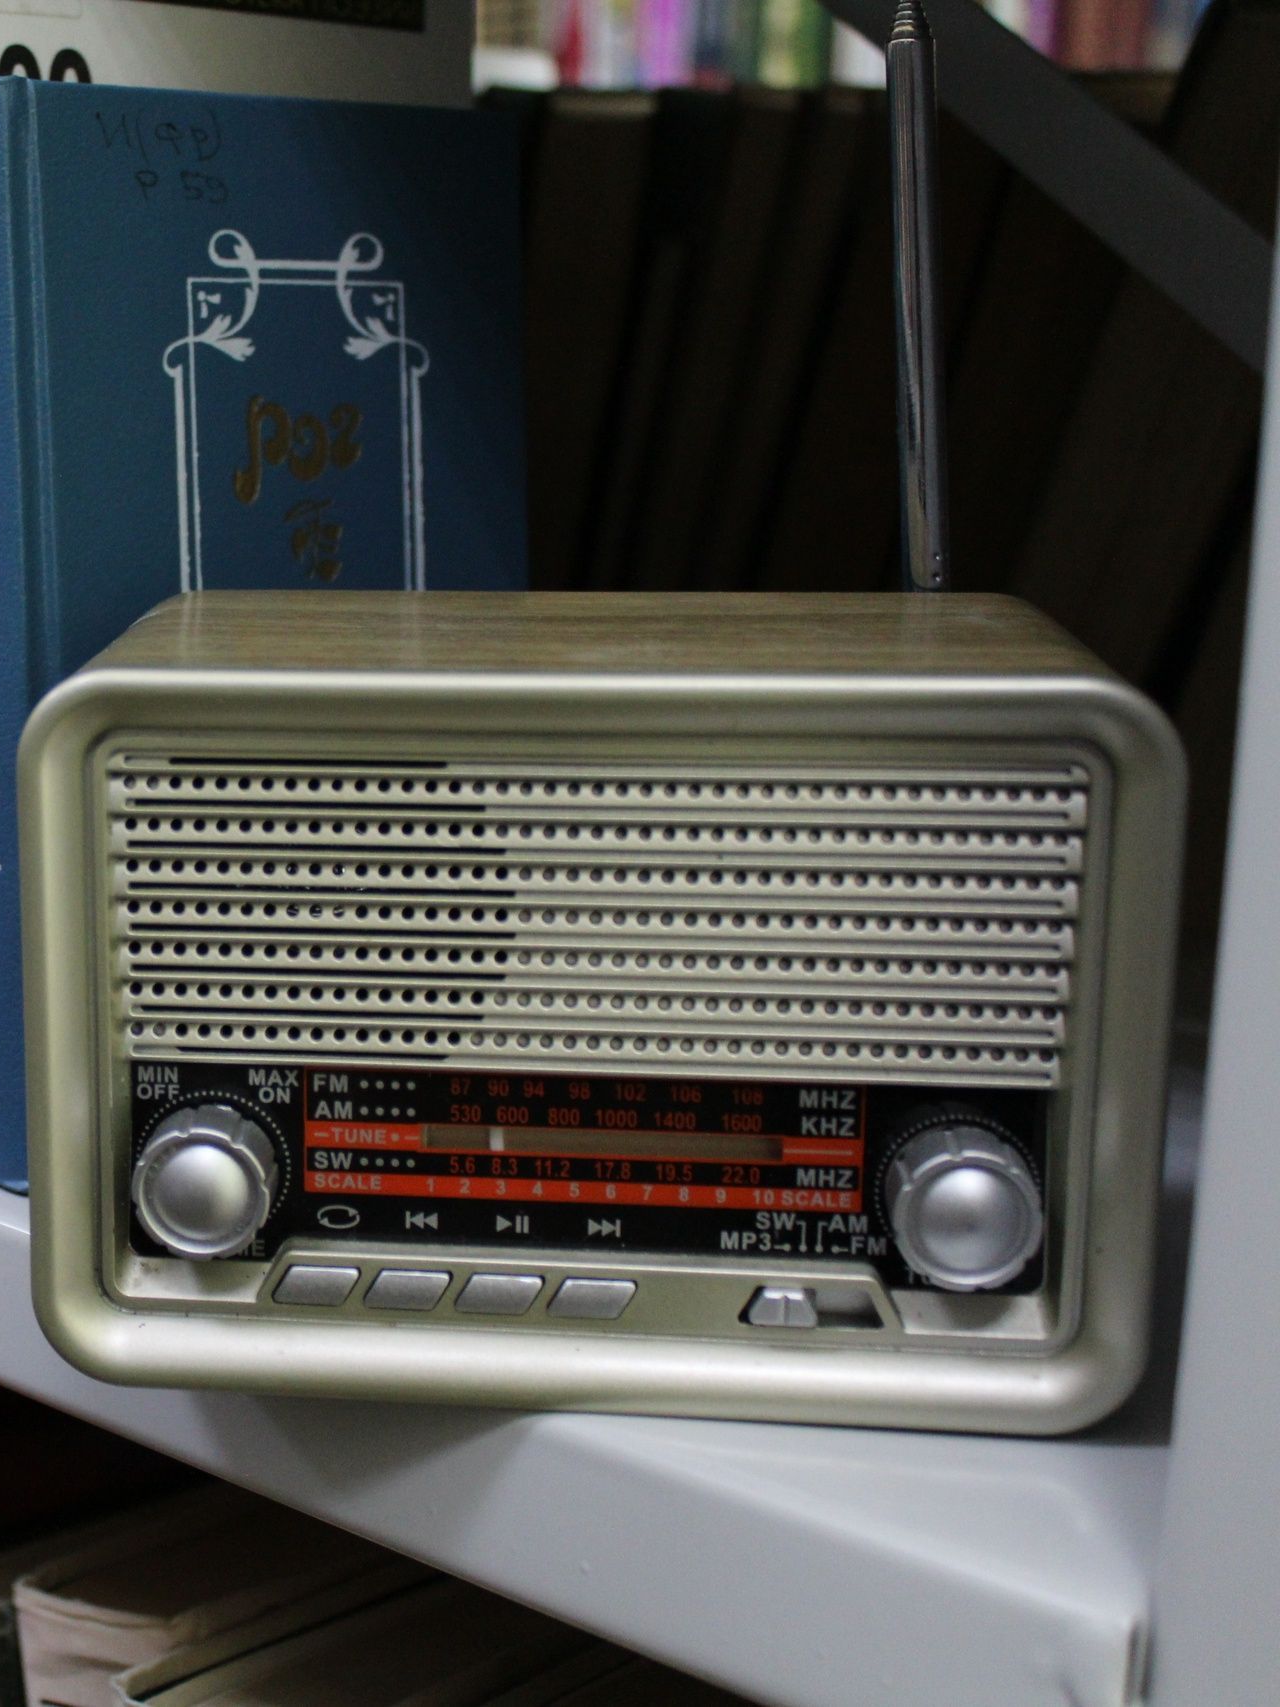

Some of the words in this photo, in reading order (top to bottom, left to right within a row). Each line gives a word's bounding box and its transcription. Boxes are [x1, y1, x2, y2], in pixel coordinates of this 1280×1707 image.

[137, 1066, 178, 1083] MIN
[249, 1069, 298, 1087] MAX
[137, 1084, 180, 1100] OFF
[259, 1087, 290, 1103] ON
[314, 1074, 348, 1093] FM
[451, 1078, 469, 1095] 87
[489, 1080, 509, 1096] 90
[523, 1080, 544, 1098] 94
[570, 1082, 590, 1099] 98
[615, 1083, 647, 1101] 102
[671, 1086, 702, 1103] 106
[732, 1088, 764, 1106] 108
[799, 1089, 856, 1110] MHZ
[314, 1101, 352, 1120] AM
[451, 1105, 480, 1122] 530
[497, 1106, 528, 1124] 600
[548, 1108, 580, 1125] 800
[595, 1110, 637, 1128] 1000
[654, 1112, 696, 1130] 1400
[723, 1114, 762, 1132] 1600
[802, 1117, 855, 1137] KHZ
[331, 1127, 386, 1144] TUNE
[314, 1152, 353, 1169] SW
[450, 1157, 475, 1173] 5.6
[492, 1158, 518, 1175] 8.3
[535, 1160, 570, 1178] 11.2
[595, 1161, 631, 1179] 17.8
[656, 1164, 693, 1182] 19.5
[722, 1166, 761, 1184] 22.0
[797, 1168, 853, 1189] MHZ
[314, 1175, 382, 1190] SCALE
[426, 1178, 435, 1193] 1
[459, 1180, 470, 1194] 2
[496, 1180, 506, 1195] 3
[532, 1181, 543, 1196] 4
[569, 1182, 580, 1197] 5
[605, 1184, 616, 1199] 6
[642, 1185, 653, 1201] 7
[678, 1186, 690, 1202] 8
[715, 1188, 726, 1204] 9
[753, 1189, 775, 1206] 10
[782, 1191, 852, 1208] SCALE
[756, 1212, 796, 1231] SW
[828, 1214, 868, 1234] AM
[720, 1230, 772, 1251] MP3
[851, 1236, 887, 1256] FM
